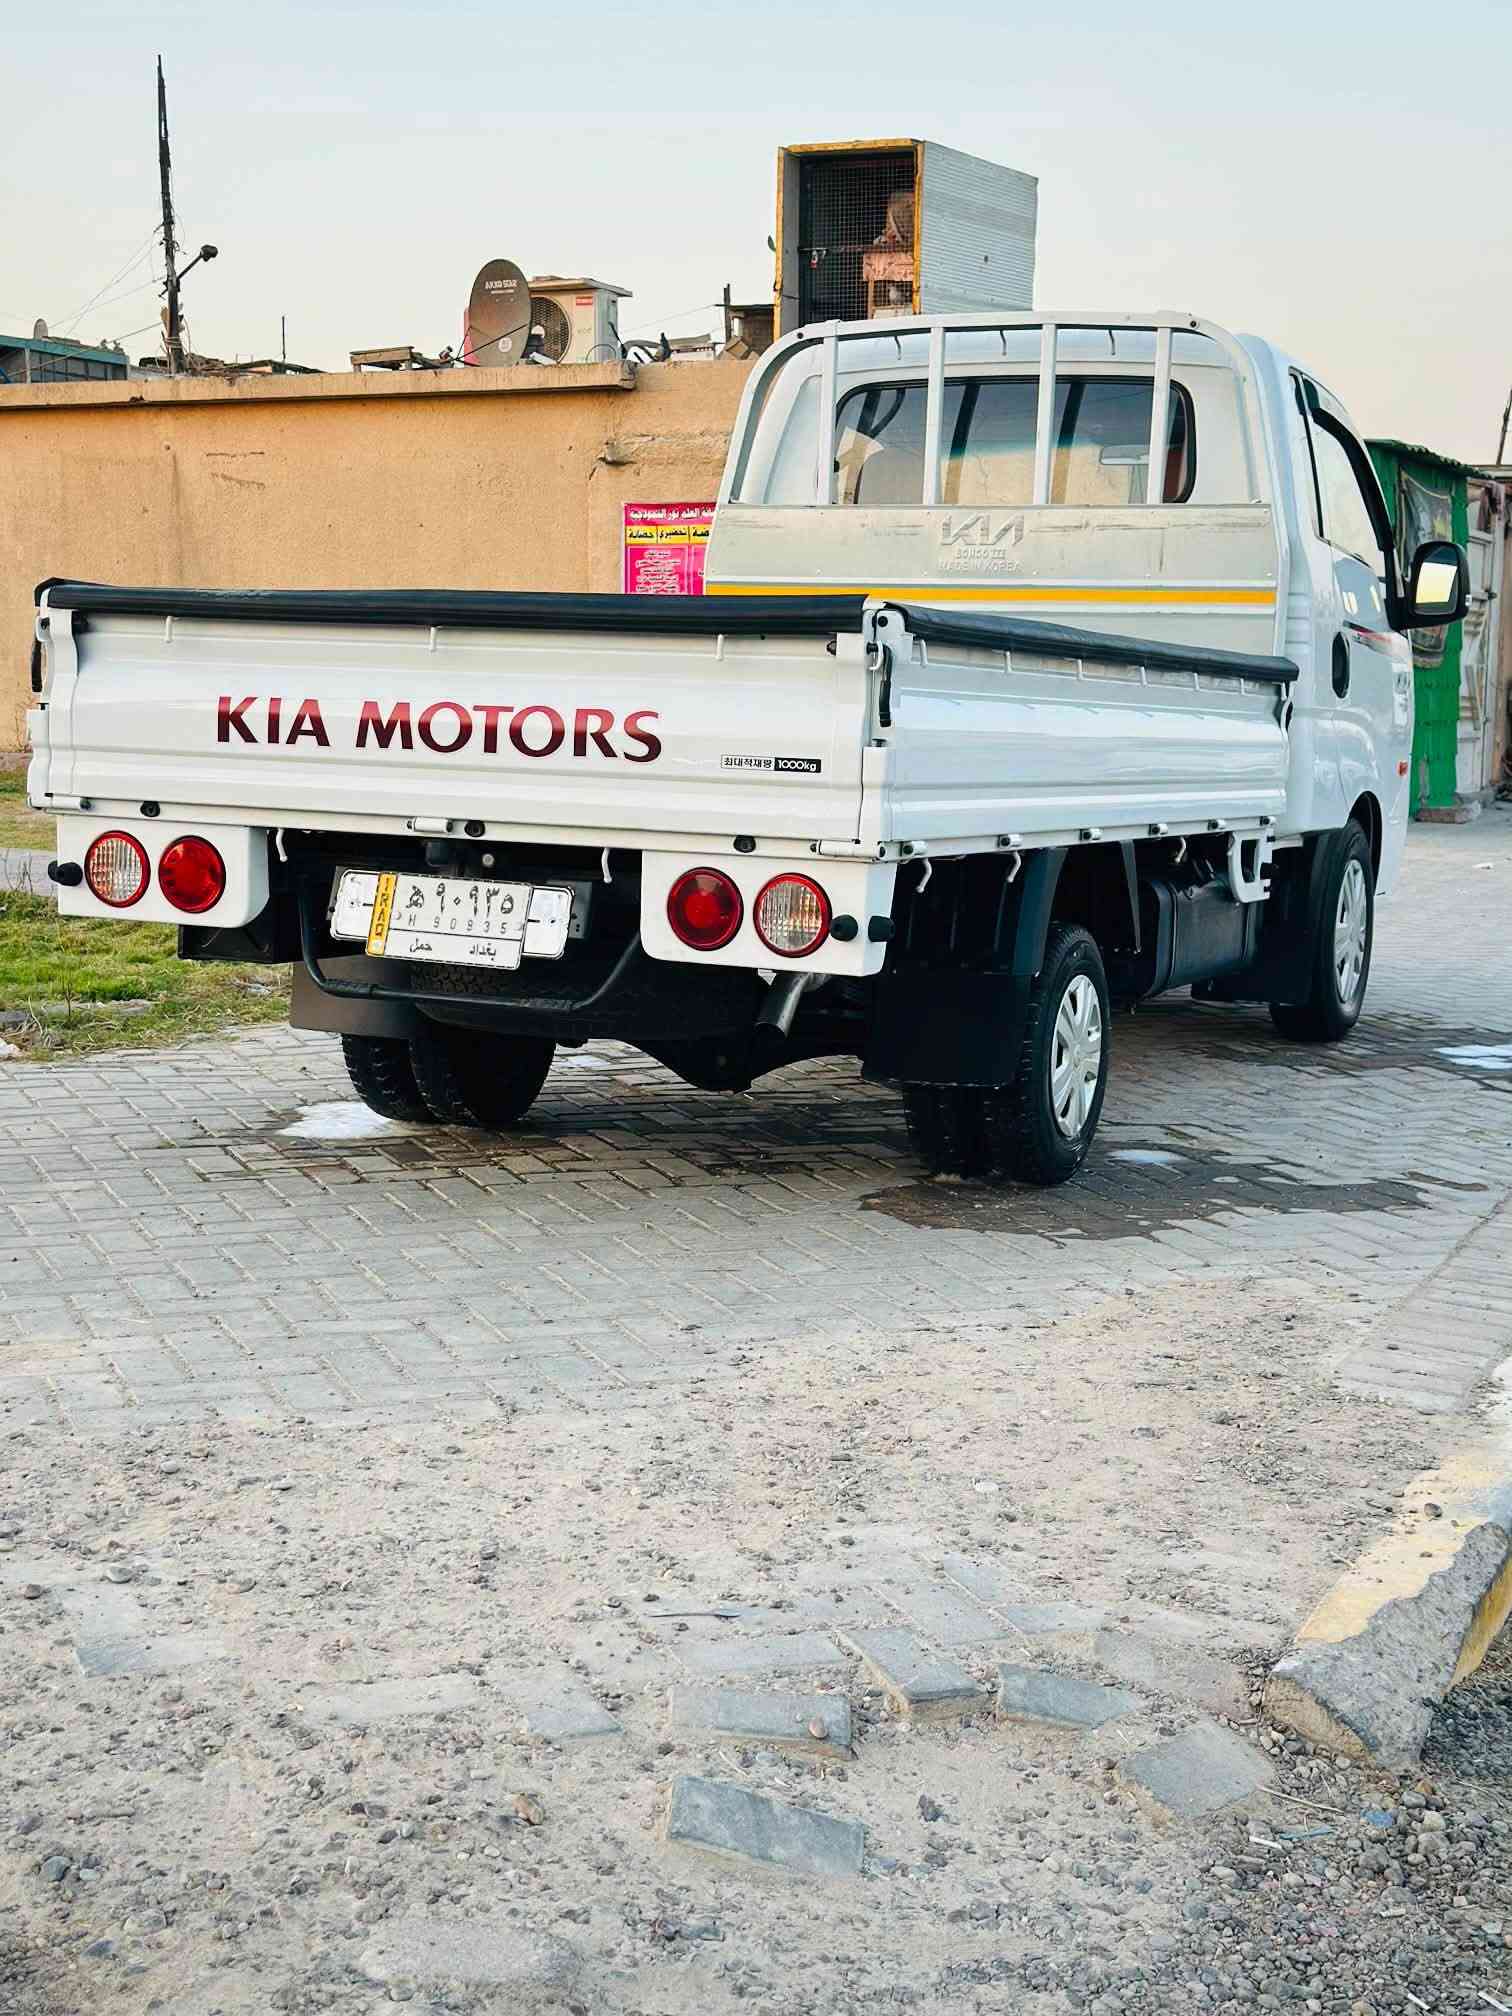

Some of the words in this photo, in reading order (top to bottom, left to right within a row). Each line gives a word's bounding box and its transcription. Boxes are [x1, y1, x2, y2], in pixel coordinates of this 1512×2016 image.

[941, 512, 1024, 546] KIA
[217, 696, 331, 748] KIA
[355, 701, 662, 763] MOTORS
[778, 760, 817, 772] 1000kg
[409, 938, 433, 953] حمل
[469, 943, 497, 960] بغداد
